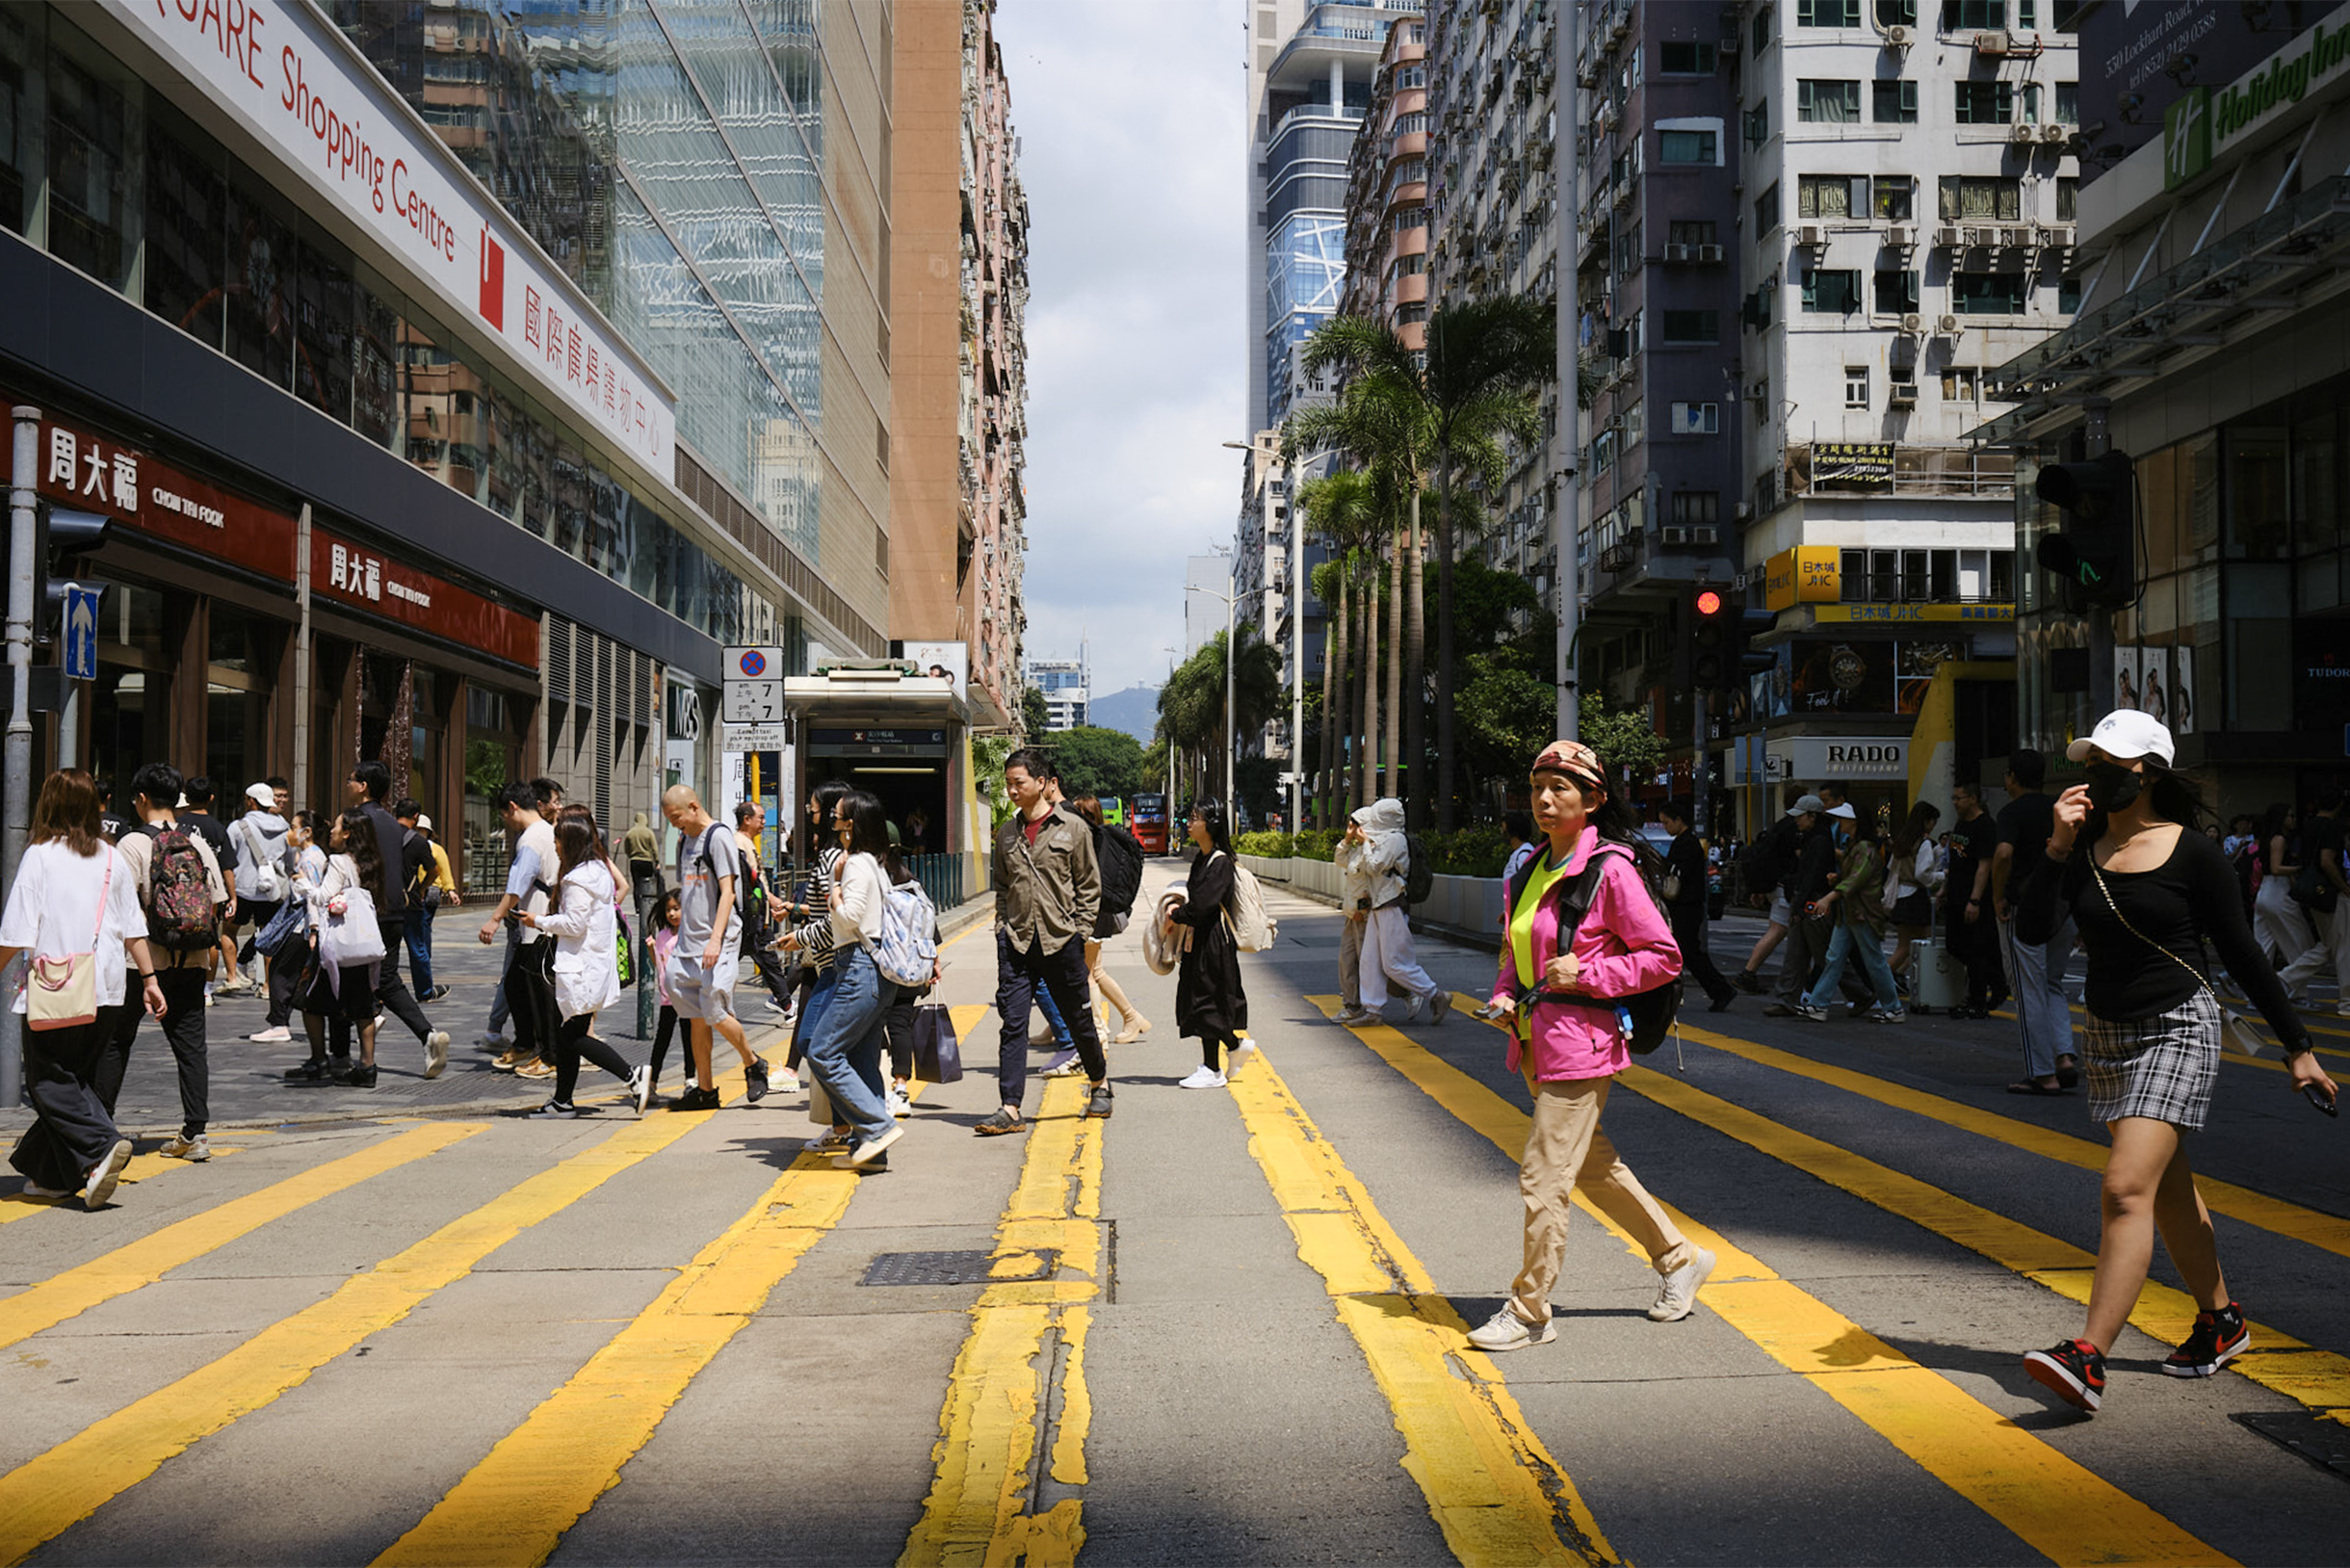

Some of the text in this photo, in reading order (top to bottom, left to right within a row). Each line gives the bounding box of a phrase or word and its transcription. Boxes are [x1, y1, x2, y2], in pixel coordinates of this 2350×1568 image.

[2124, 20, 2163, 65] Lockhart
[2129, 66, 2141, 90] tel
[2141, 49, 2165, 83] (852)
[2216, 51, 2311, 141] Holiday
[281, 44, 384, 214] Shopping
[391, 158, 455, 262] Centre
[49, 427, 138, 512] 周大福
[152, 487, 182, 512] CHOW
[330, 543, 380, 601] 周大福
[1803, 562, 1836, 573] 日本城
[1807, 575, 1832, 587] JHC
[1850, 606, 2017, 620] 日本城 JHC 美麗都大
[2307, 667, 2350, 678] TUDOR
[736, 690, 753, 698] 上午
[762, 684, 772, 697] 7
[676, 685, 700, 742] M&S
[762, 705, 772, 719] 7
[1828, 745, 1900, 762] RADO
